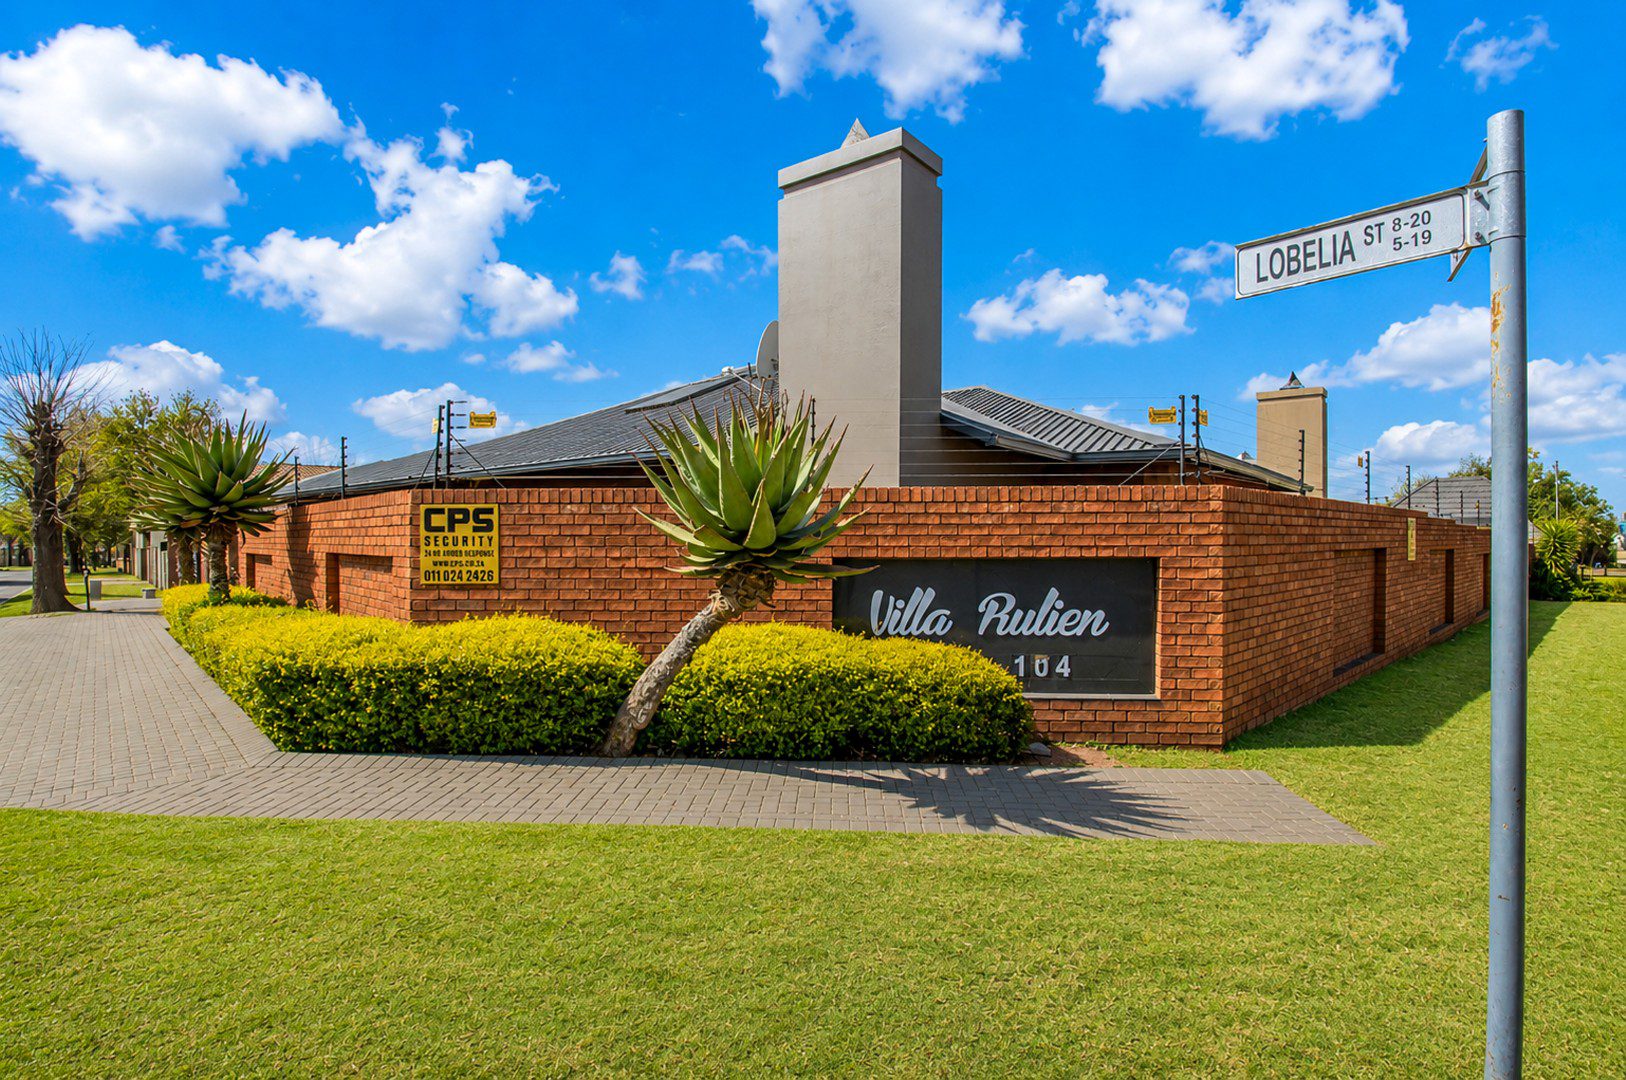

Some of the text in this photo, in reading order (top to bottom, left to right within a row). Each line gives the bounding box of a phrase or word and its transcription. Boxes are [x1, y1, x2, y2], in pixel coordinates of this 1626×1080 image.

[1256, 210, 1431, 284] LOBELIA ST 8-20
[1392, 230, 1432, 251] 5-19
[424, 508, 494, 532] CPS
[424, 535, 493, 547] SECURITY
[424, 570, 494, 581] 011 024 2426
[870, 586, 1110, 637] Villa Rulien
[1014, 654, 1071, 678] 104
